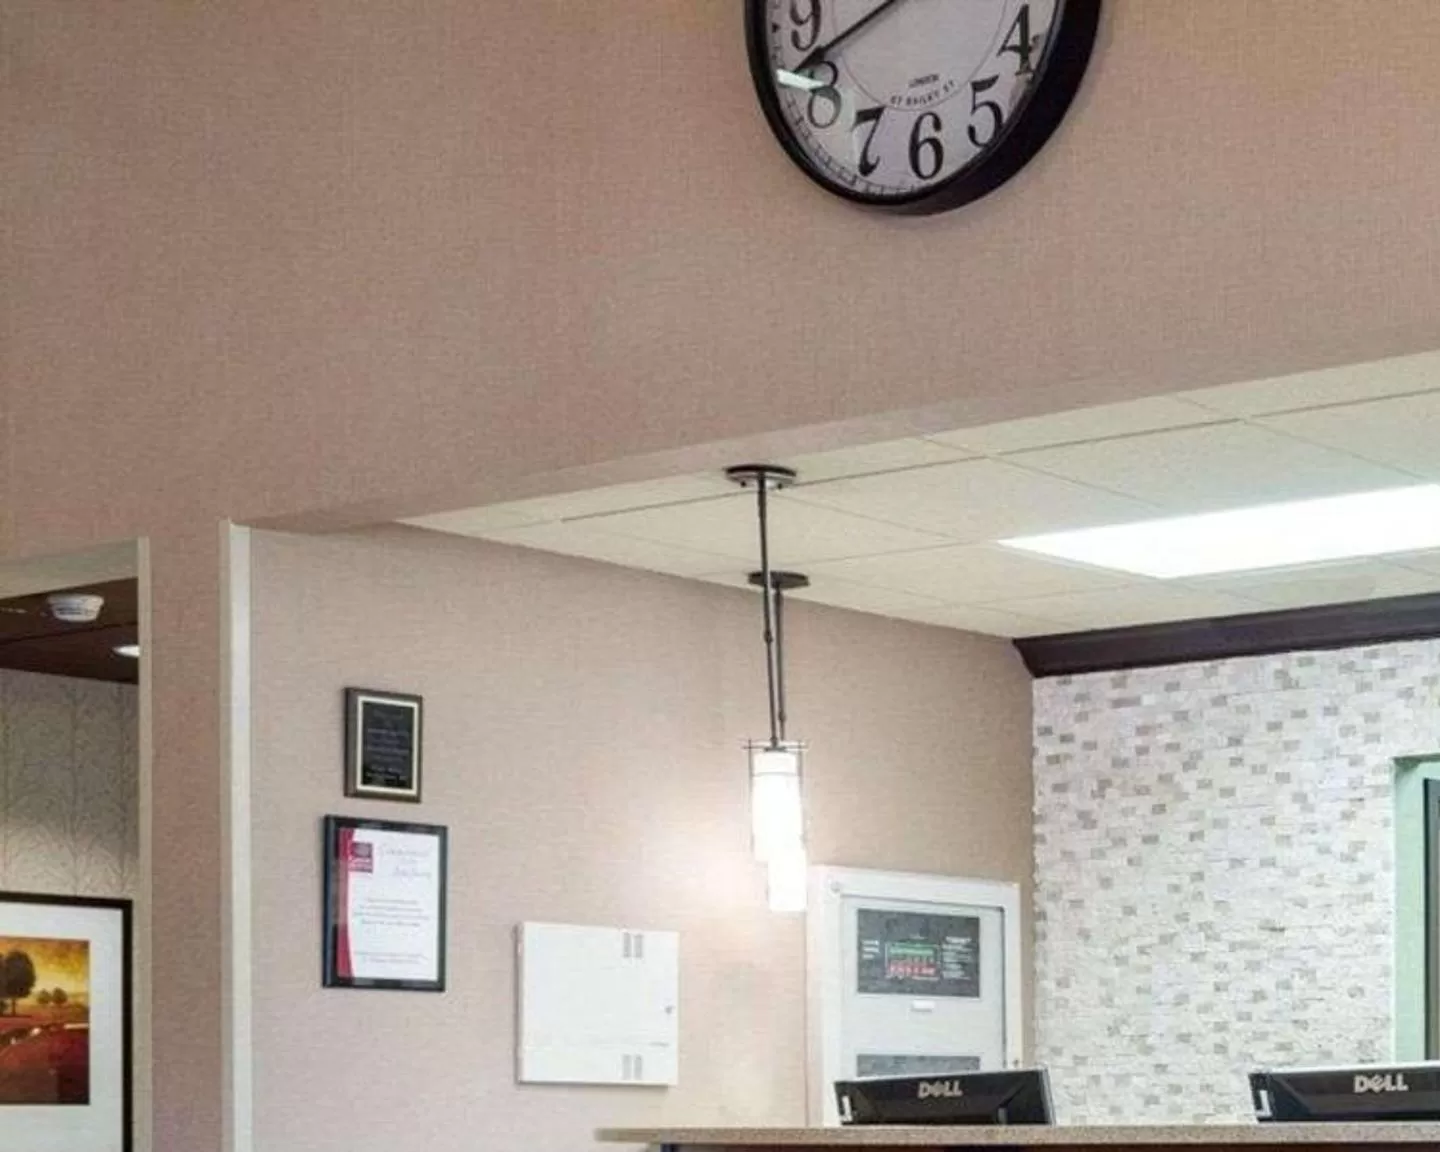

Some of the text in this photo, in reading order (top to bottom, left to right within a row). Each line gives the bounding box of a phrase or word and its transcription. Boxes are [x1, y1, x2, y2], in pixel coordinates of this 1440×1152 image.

[790, 0, 821, 51] 9
[996, 4, 1034, 76] 4
[807, 60, 842, 129] 8
[967, 72, 1003, 147] 5
[851, 105, 886, 176] 7
[908, 112, 944, 180] 6
[918, 1080, 963, 1098] DELL
[1354, 1074, 1409, 1093] DELL
